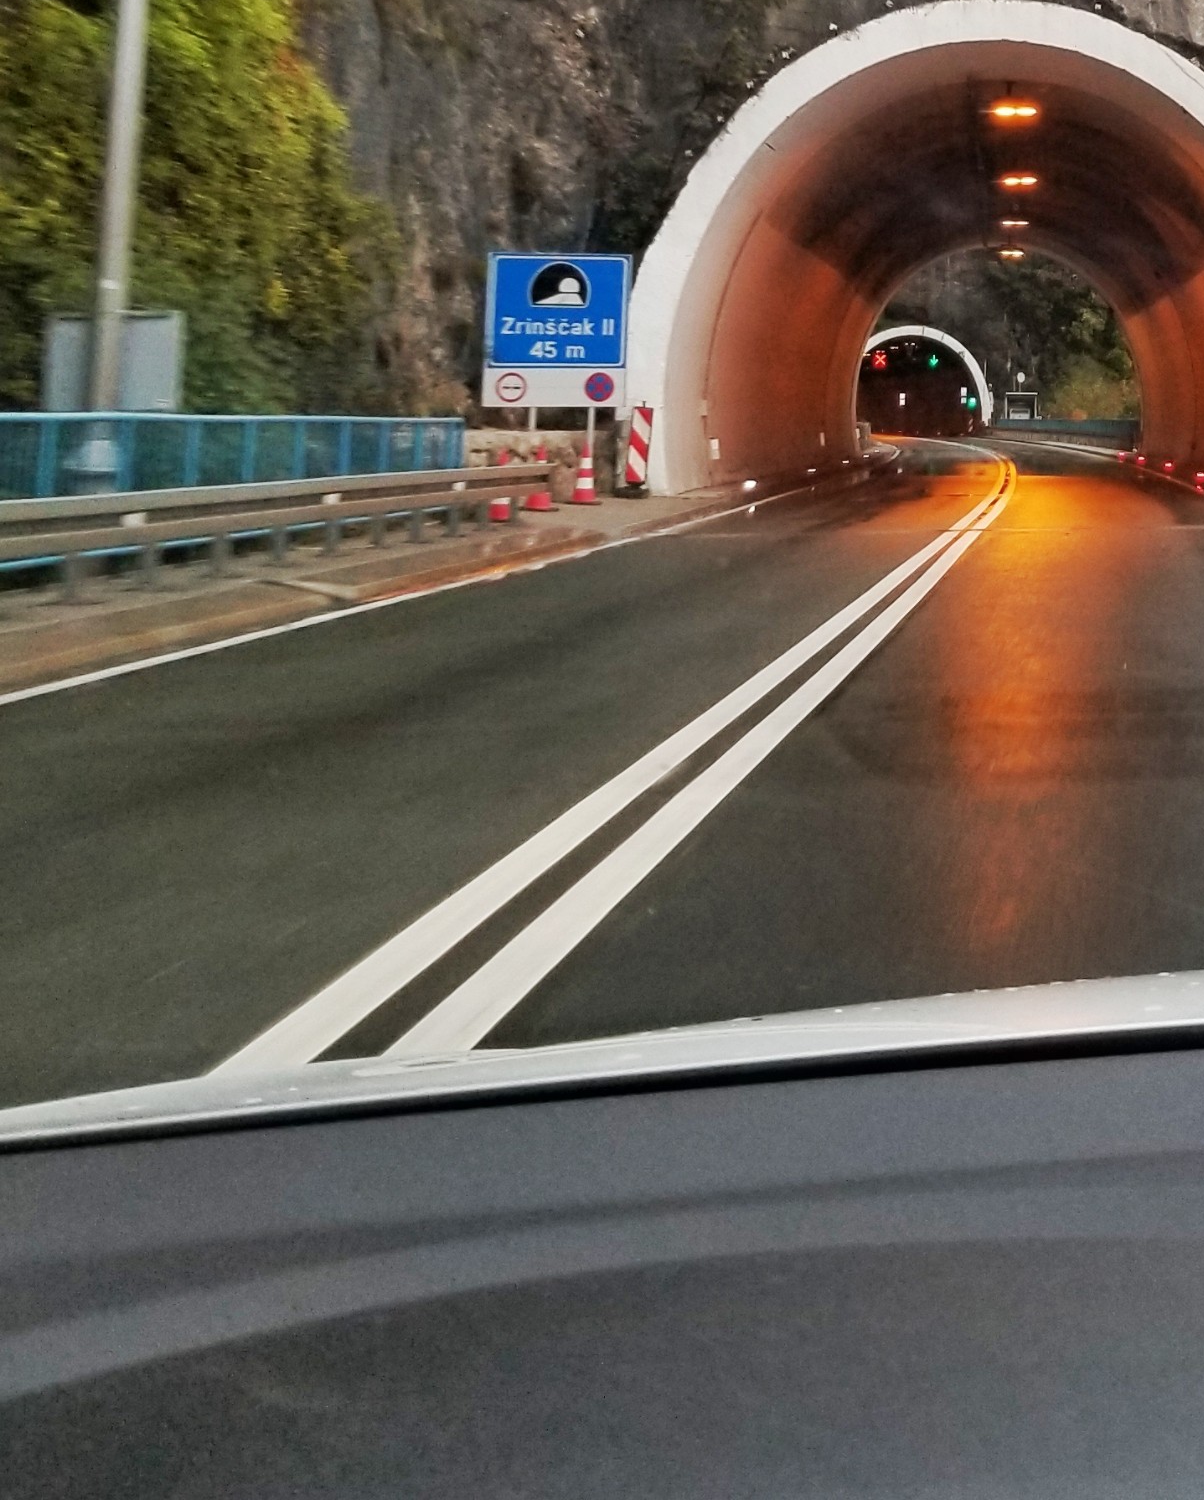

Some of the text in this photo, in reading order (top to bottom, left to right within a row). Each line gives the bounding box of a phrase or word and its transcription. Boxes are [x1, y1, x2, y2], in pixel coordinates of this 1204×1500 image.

[500, 316, 615, 336] Zrinščak II
[529, 341, 585, 358] 45 m
